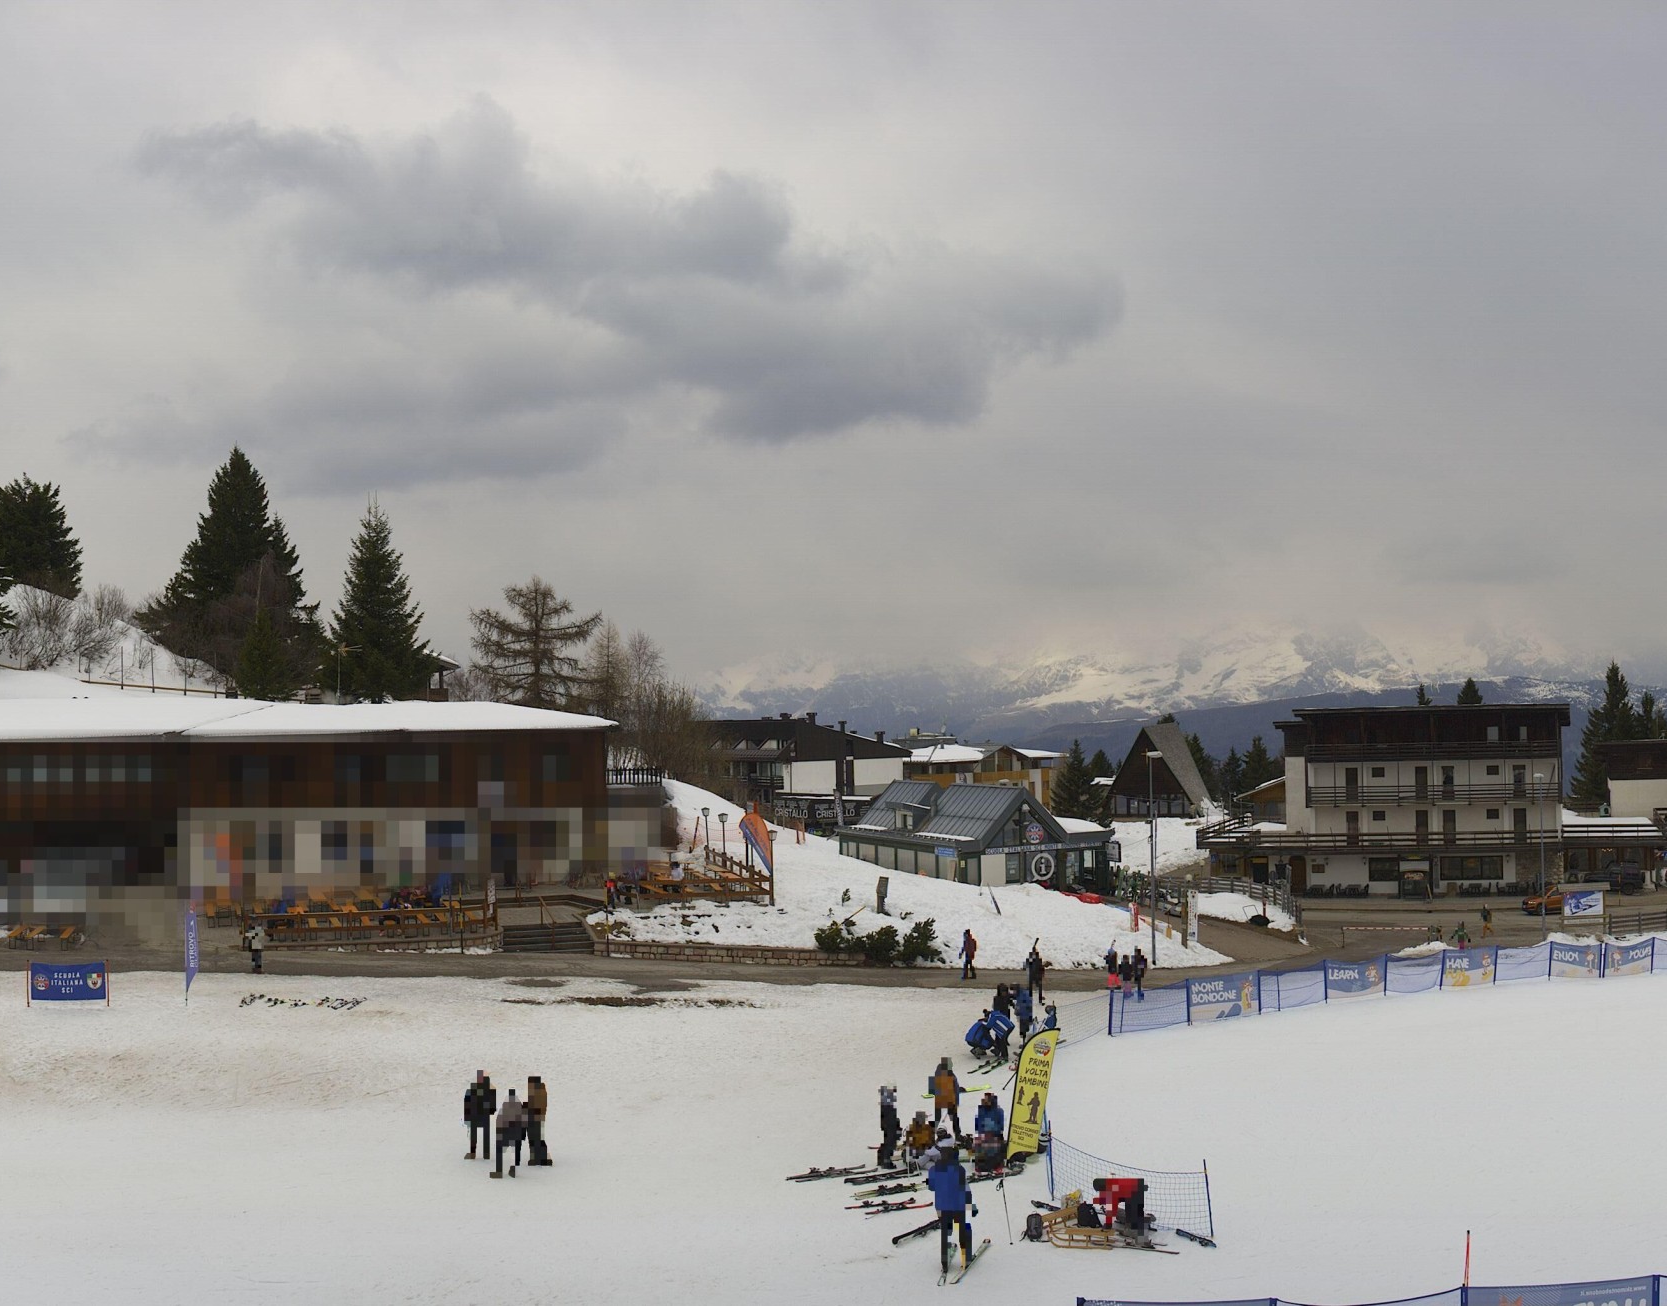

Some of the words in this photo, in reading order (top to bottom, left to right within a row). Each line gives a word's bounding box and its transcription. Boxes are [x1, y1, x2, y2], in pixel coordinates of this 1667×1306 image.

[774, 808, 808, 818] CRSTALLO
[816, 808, 856, 818] CRISTLLO
[1552, 950, 1579, 962] ENJOY
[1446, 958, 1470, 968] HAVE
[1328, 968, 1359, 980] LEARN
[1192, 980, 1224, 994] MONTE
[1192, 990, 1237, 1004] BONDONE
[1028, 1058, 1050, 1069] PRIMA
[1025, 1066, 1048, 1080] VOLTA
